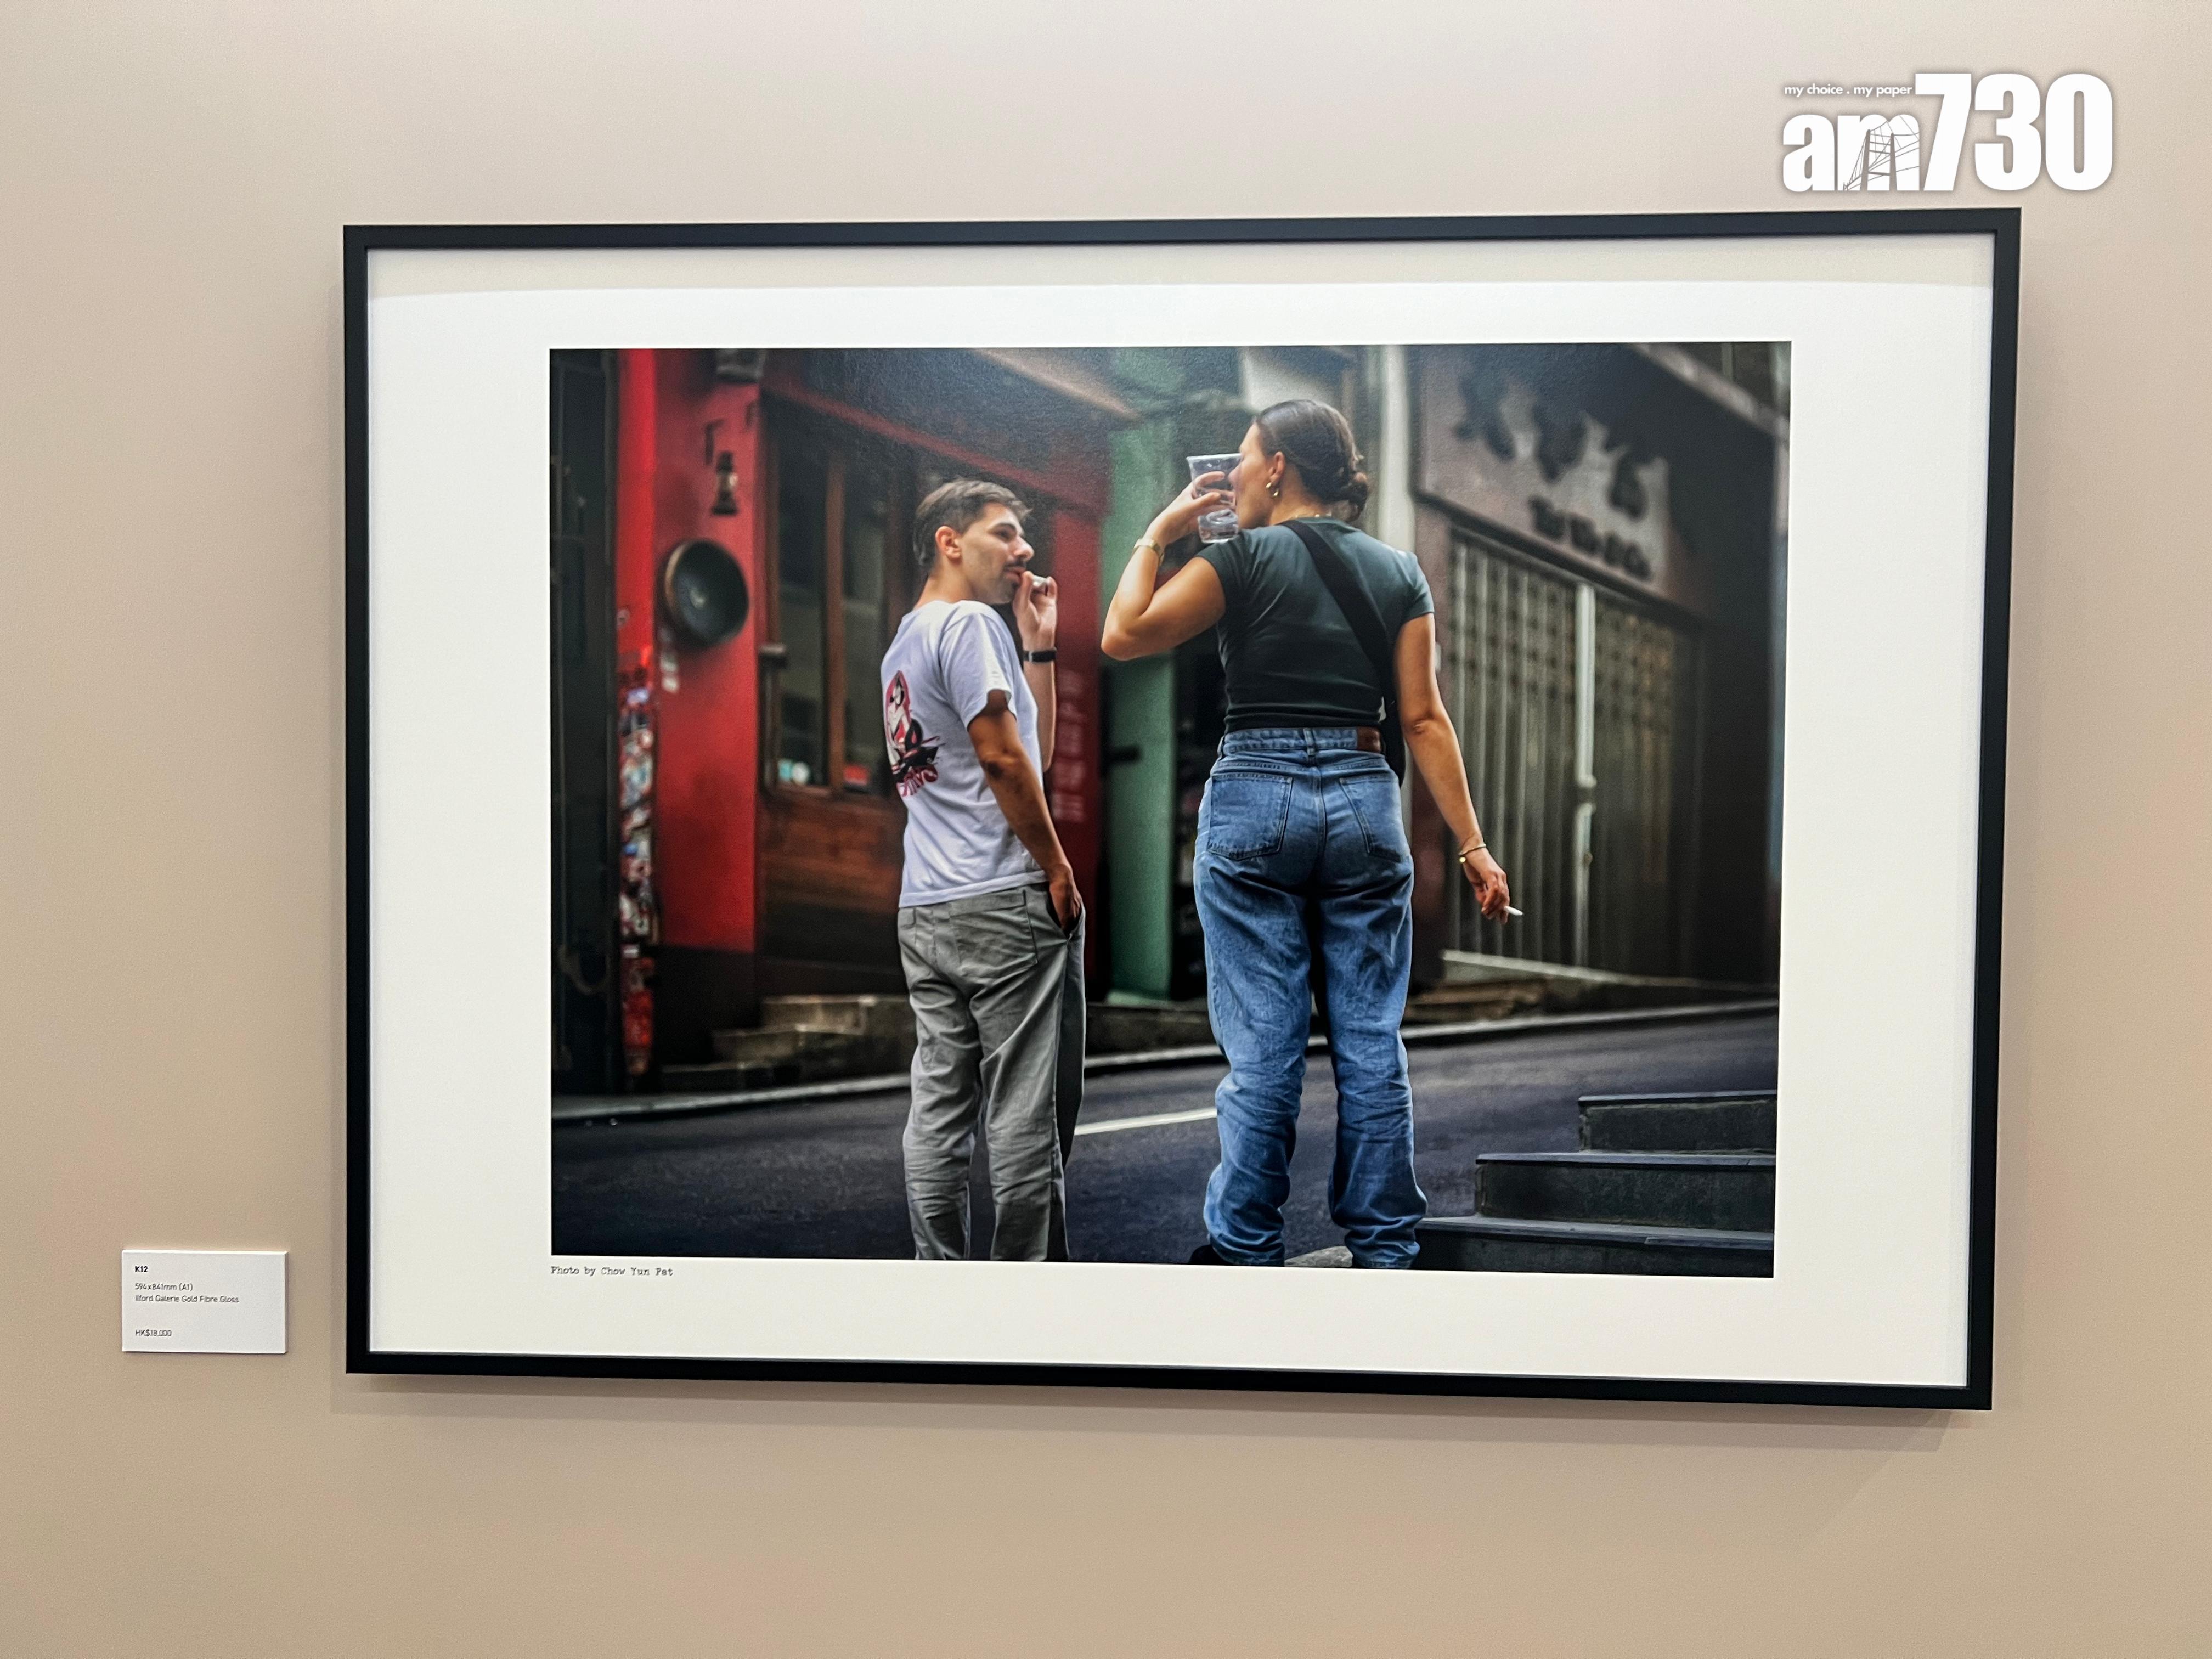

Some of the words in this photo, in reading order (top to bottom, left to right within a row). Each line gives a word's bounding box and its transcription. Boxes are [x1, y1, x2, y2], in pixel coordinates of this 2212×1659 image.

[551, 1266, 579, 1274] Photo
[584, 1267, 596, 1277] by
[601, 1267, 625, 1276] Chow
[631, 1267, 650, 1276] Yun
[179, 1283, 193, 1291] (A1)
